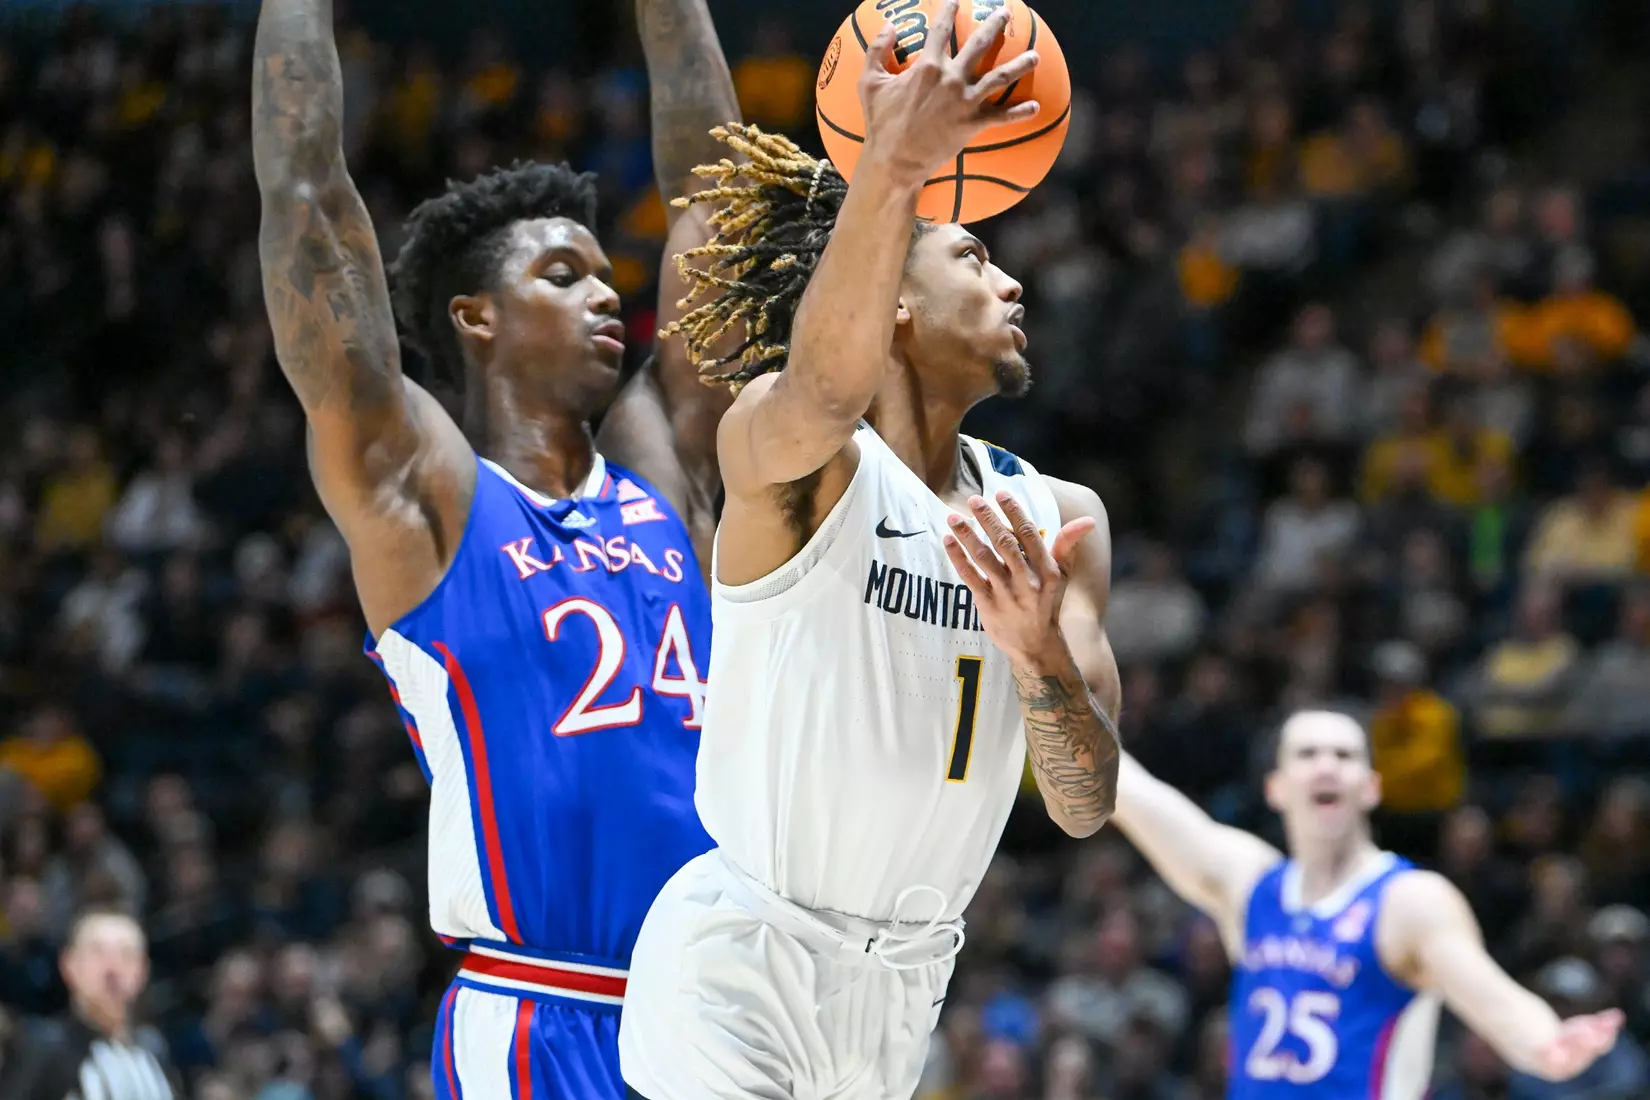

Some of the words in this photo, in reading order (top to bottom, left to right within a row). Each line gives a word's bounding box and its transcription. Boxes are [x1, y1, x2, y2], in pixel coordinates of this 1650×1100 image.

[864, 559, 986, 632] MOUNTA
[541, 596, 709, 737] 24
[945, 655, 984, 783] 1
[1245, 986, 1341, 1084] 25
